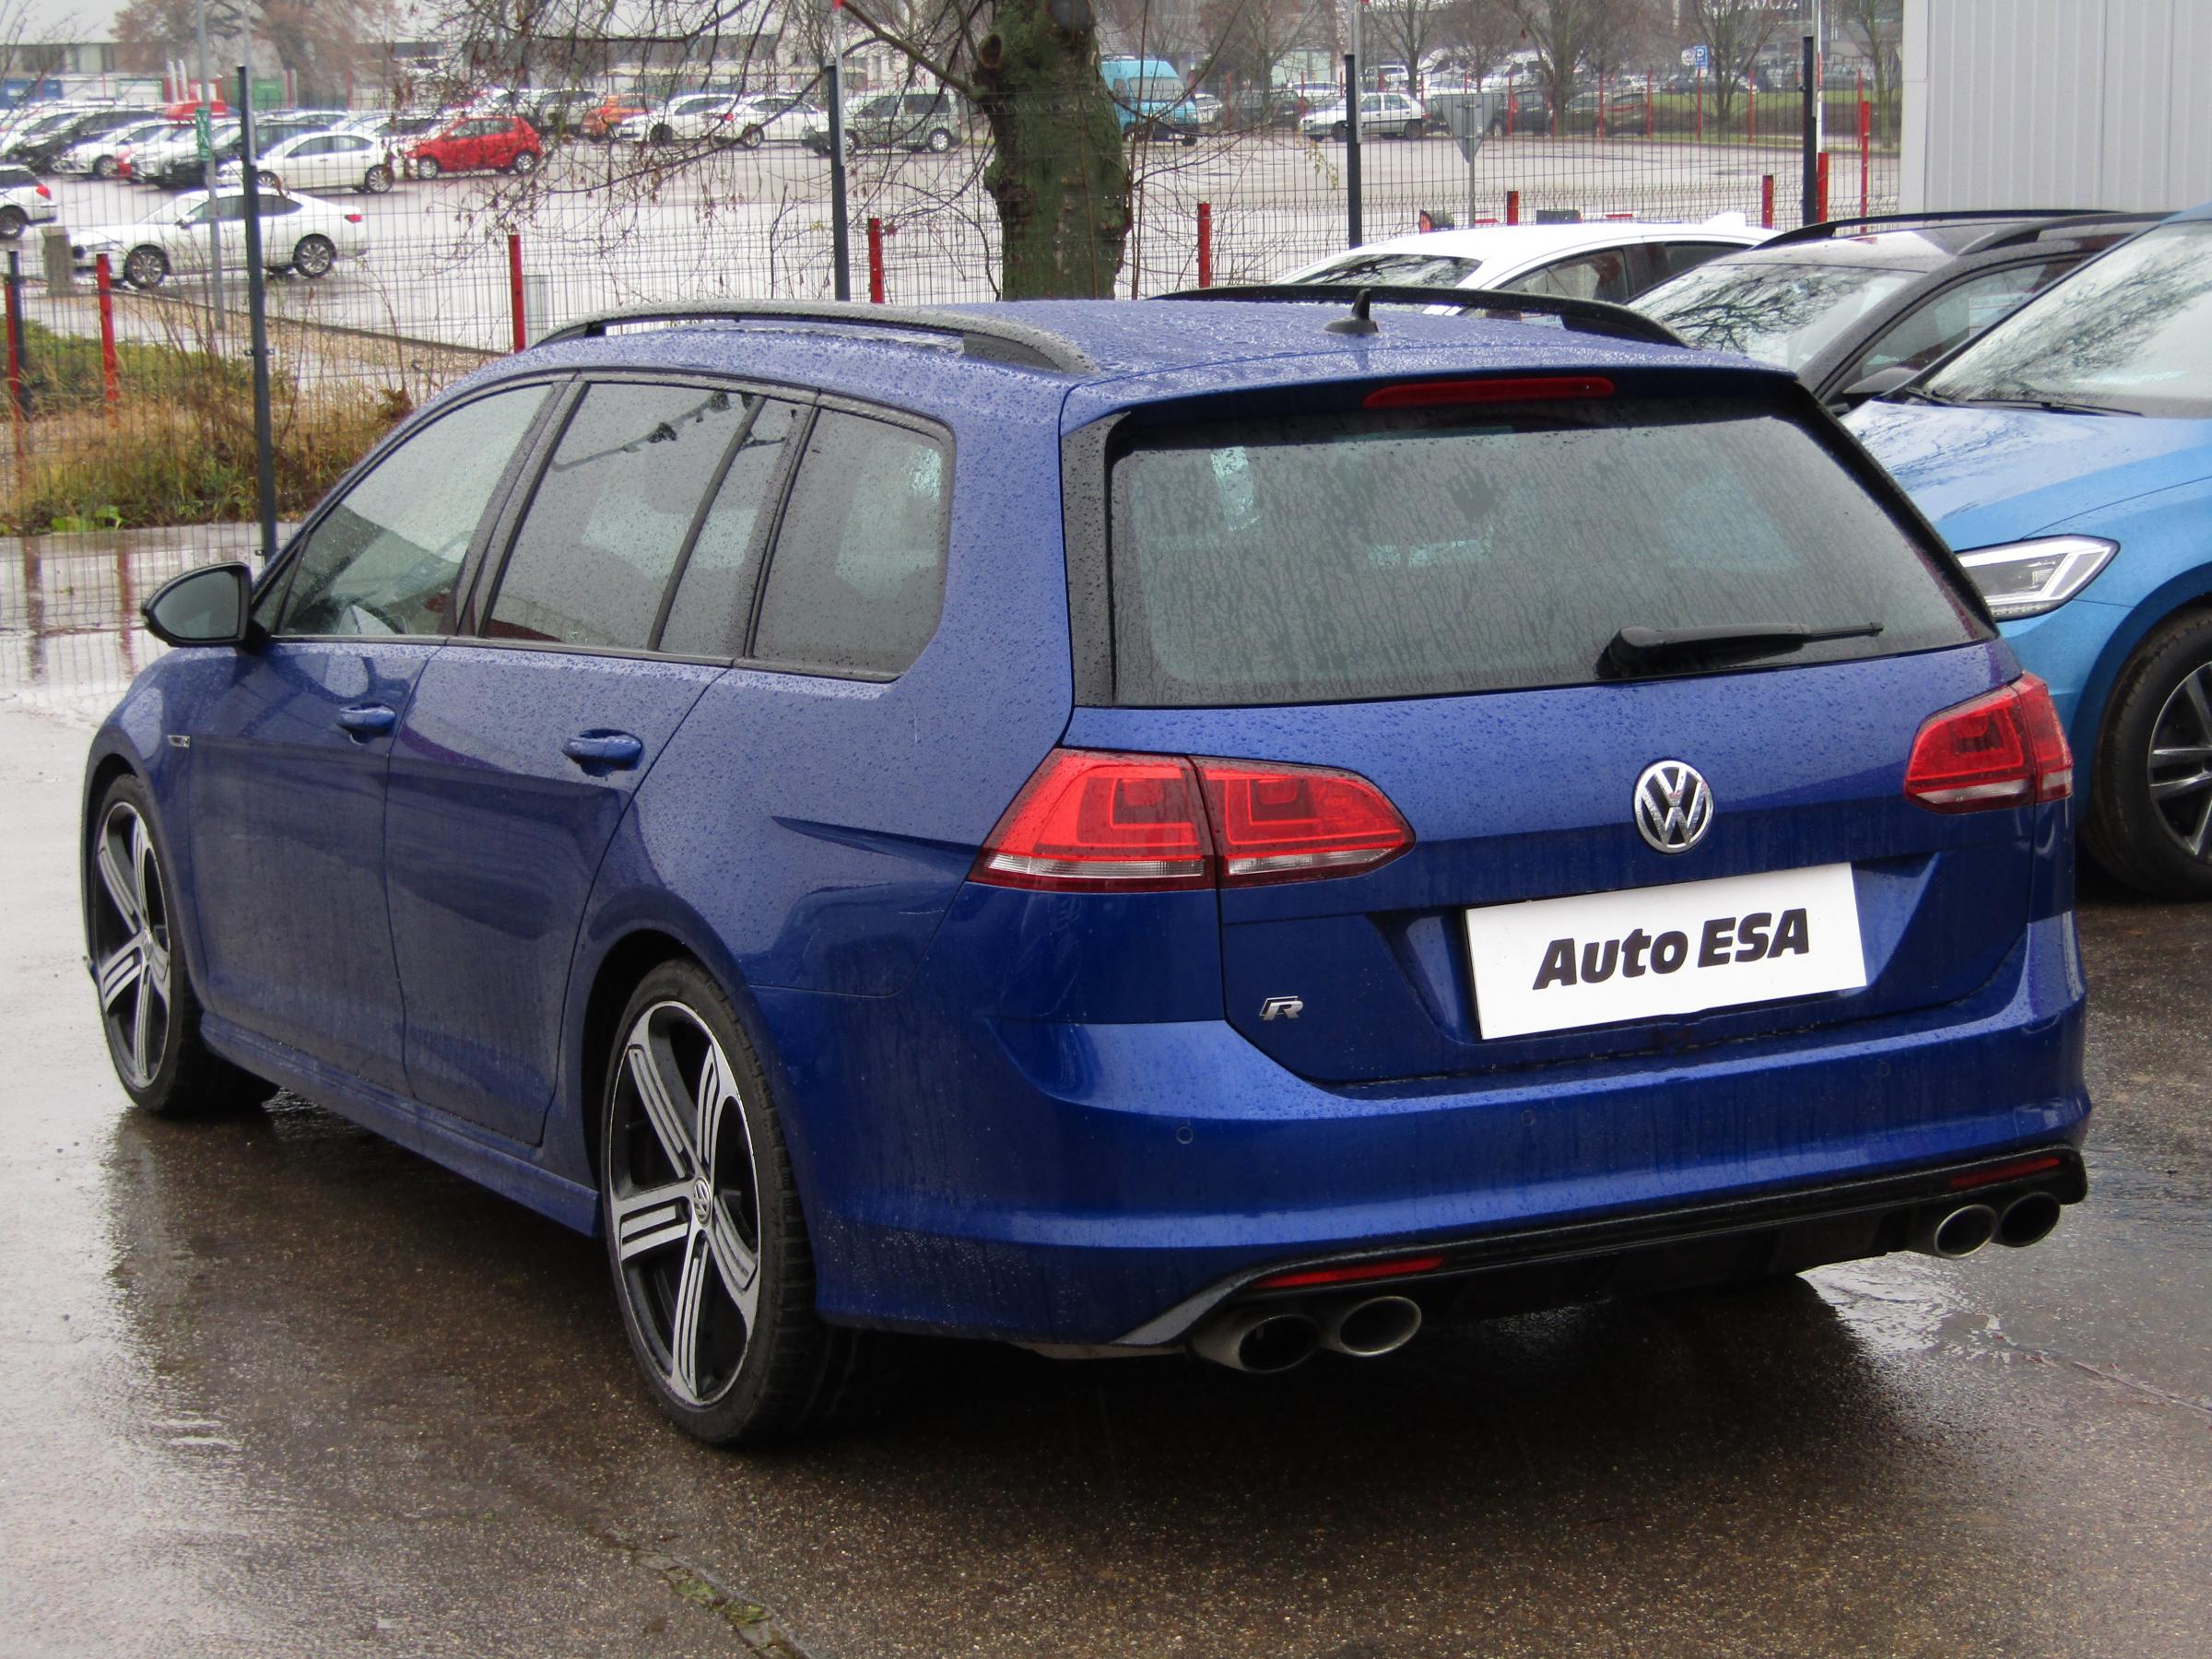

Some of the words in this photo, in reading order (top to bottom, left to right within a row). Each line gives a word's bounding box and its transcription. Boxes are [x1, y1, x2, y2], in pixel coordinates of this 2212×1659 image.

[1532, 928, 1688, 991] Auto
[1697, 908, 1809, 969] ESA
[1261, 999, 1303, 1020] R
